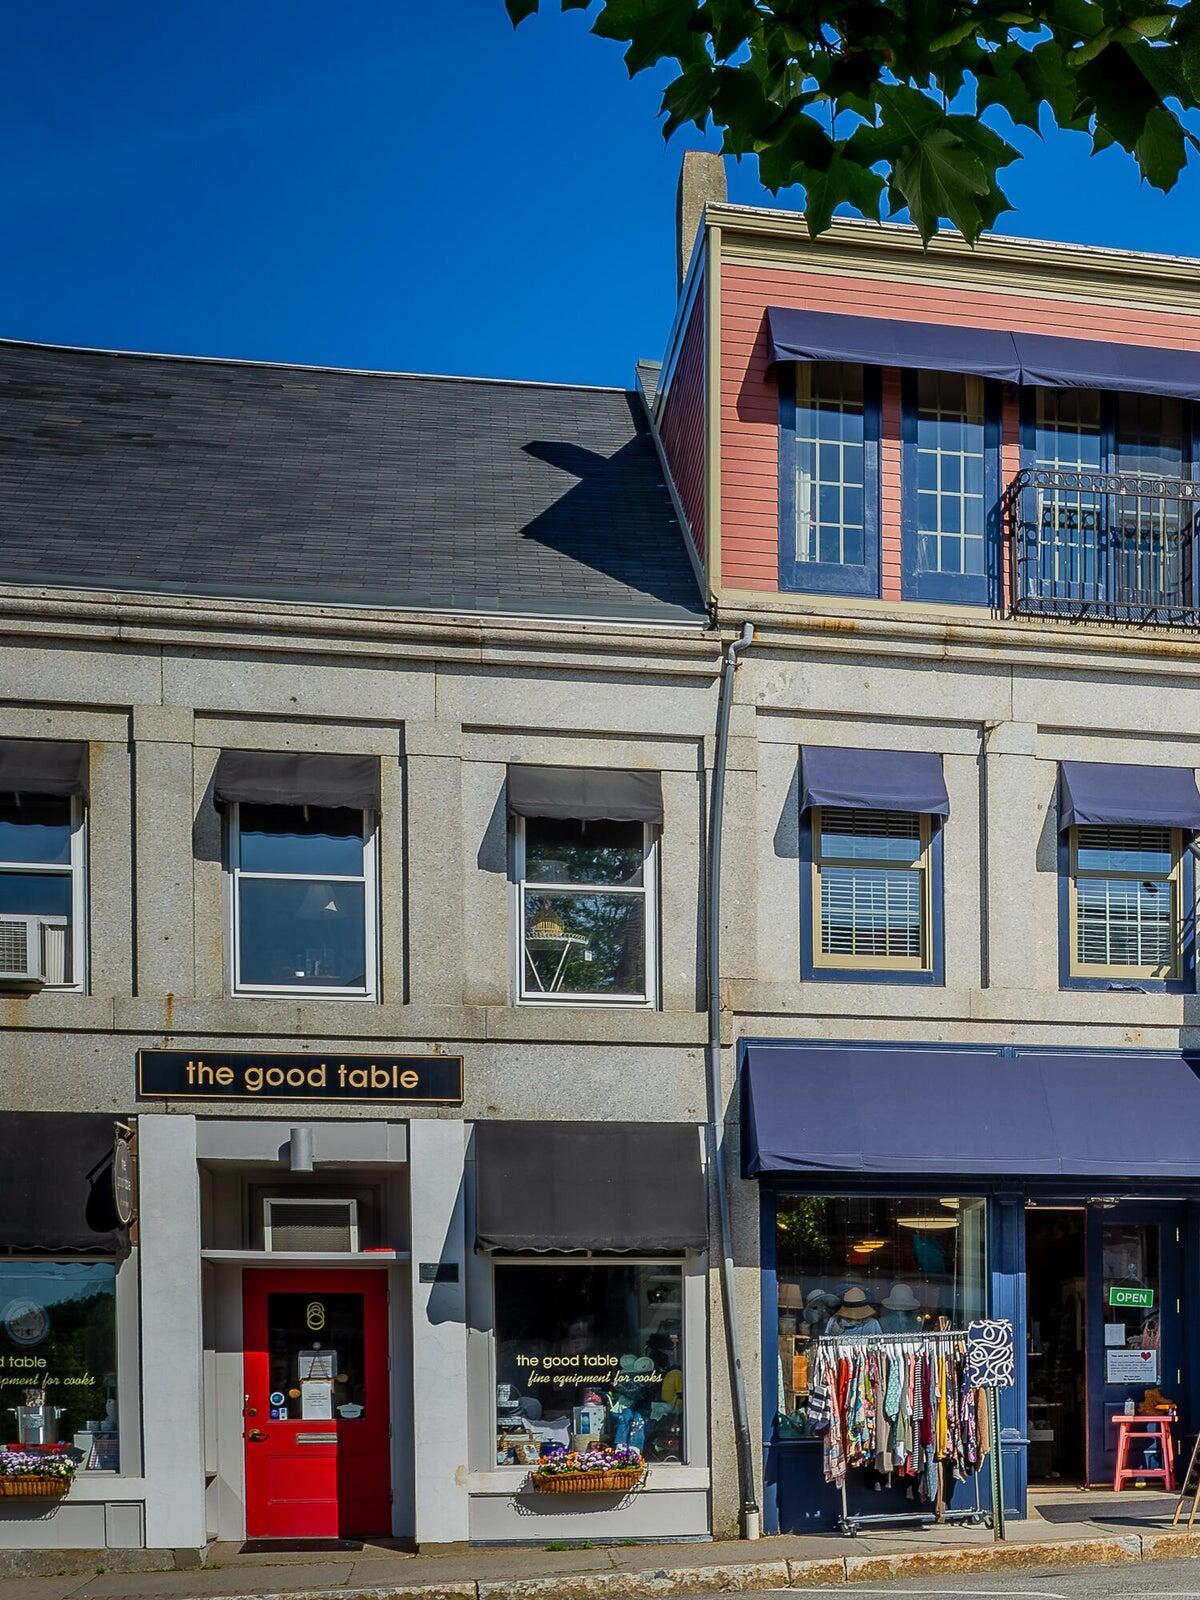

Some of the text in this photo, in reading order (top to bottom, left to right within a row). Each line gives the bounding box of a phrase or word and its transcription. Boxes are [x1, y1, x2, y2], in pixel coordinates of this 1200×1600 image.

[186, 1061, 419, 1091] the good table
[1116, 1292, 1147, 1303] OPEN
[9, 1356, 47, 1368] table
[516, 1354, 619, 1369] the good table
[42, 1371, 61, 1389] for
[63, 1372, 96, 1386] cooks
[527, 1370, 663, 1387] fine equipment for cooks
